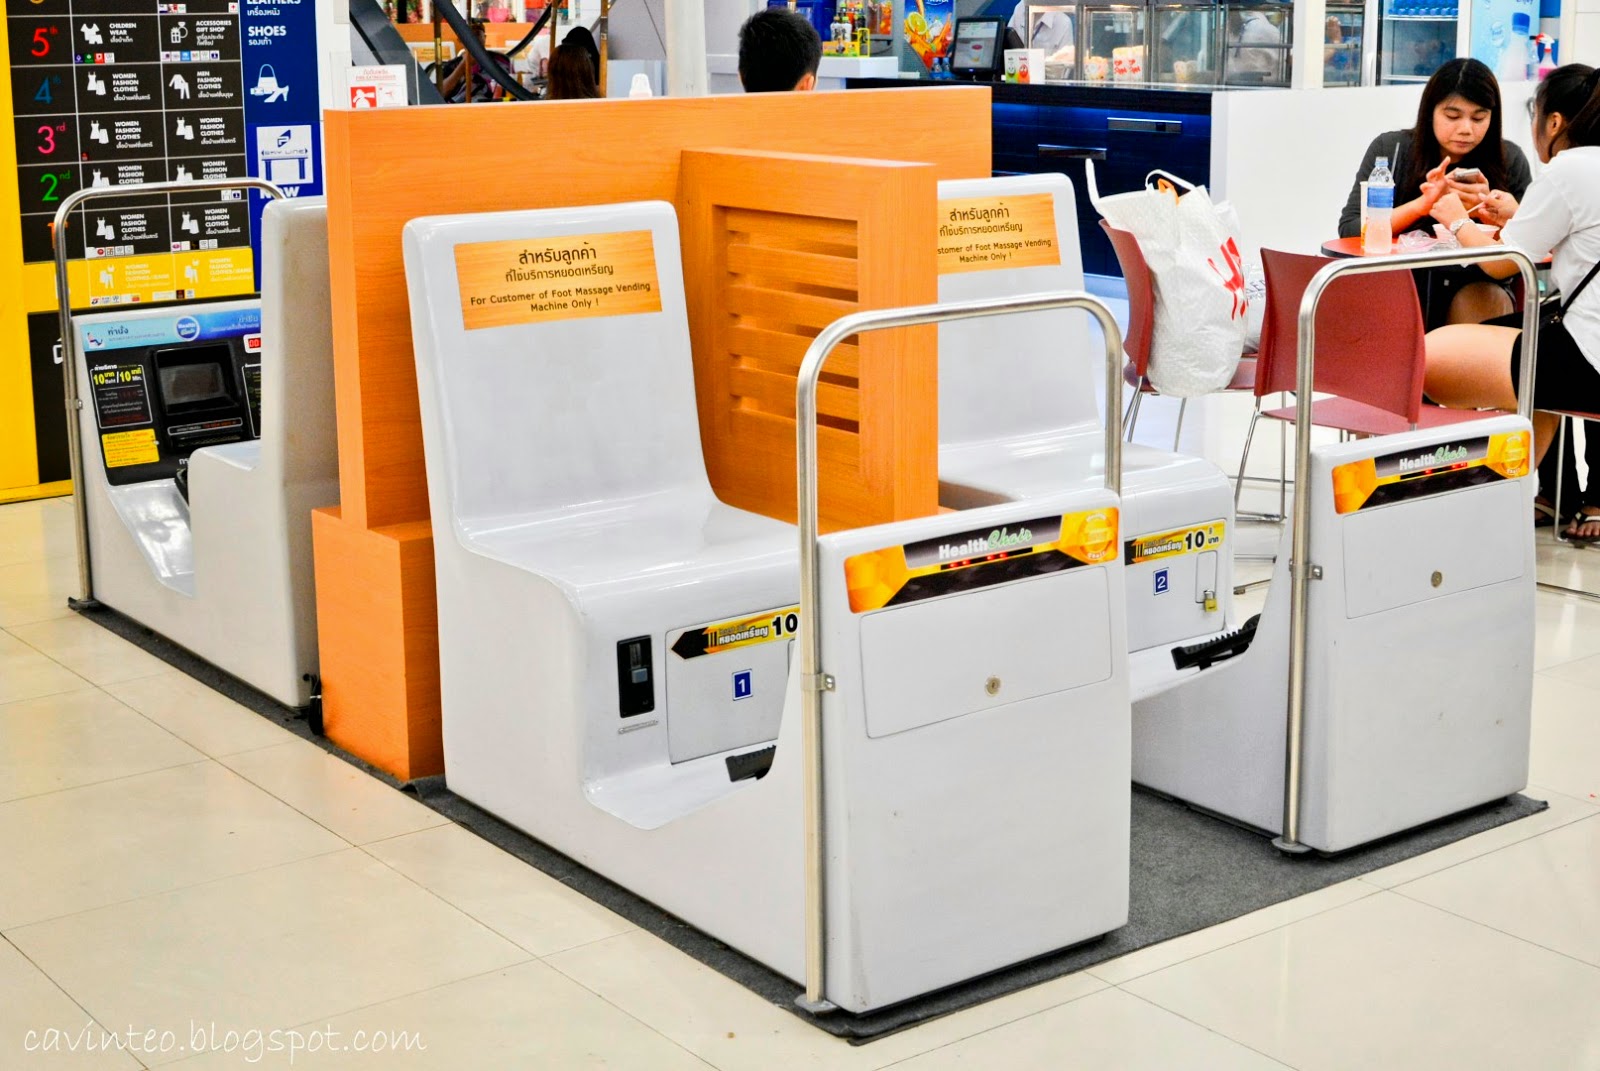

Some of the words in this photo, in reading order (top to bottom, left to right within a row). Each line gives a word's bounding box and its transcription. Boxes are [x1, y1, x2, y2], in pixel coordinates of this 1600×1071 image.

[248, 25, 287, 37] SHOES
[248, 37, 272, 46] รองเท้า
[260, 186, 300, 199] NW
[949, 202, 1010, 222] สำหรับลูกค้า
[939, 222, 1023, 237] ที่ใช้บริการหยอดเหรียญ
[518, 241, 597, 265] สำหรับลูกค้า
[937, 246, 963, 254] stomer
[976, 243, 991, 251] Foot
[993, 240, 1023, 250] Massage
[1025, 238, 1052, 248] Vending
[959, 253, 988, 263] Machine
[991, 252, 1007, 261] Only
[505, 264, 614, 283] ที่ใช้บริการหยอดเหรียญ
[470, 296, 487, 306] For
[490, 292, 536, 305] Customer
[538, 290, 548, 299] of
[552, 288, 573, 298] Foot
[575, 286, 613, 297] Massage
[616, 281, 651, 293] Vending
[530, 302, 569, 312] Machine
[571, 298, 592, 309] Only
[107, 327, 129, 336] ท่านั่ง
[94, 373, 105, 385] 10
[120, 370, 131, 382] 10
[1143, 540, 1182, 556] หยอดเหรียญ
[1185, 531, 1205, 550] 10
[1157, 576, 1166, 589] 2
[719, 626, 769, 645] หยอดเหรียญ
[772, 613, 798, 636] 10
[738, 679, 745, 693] 1
